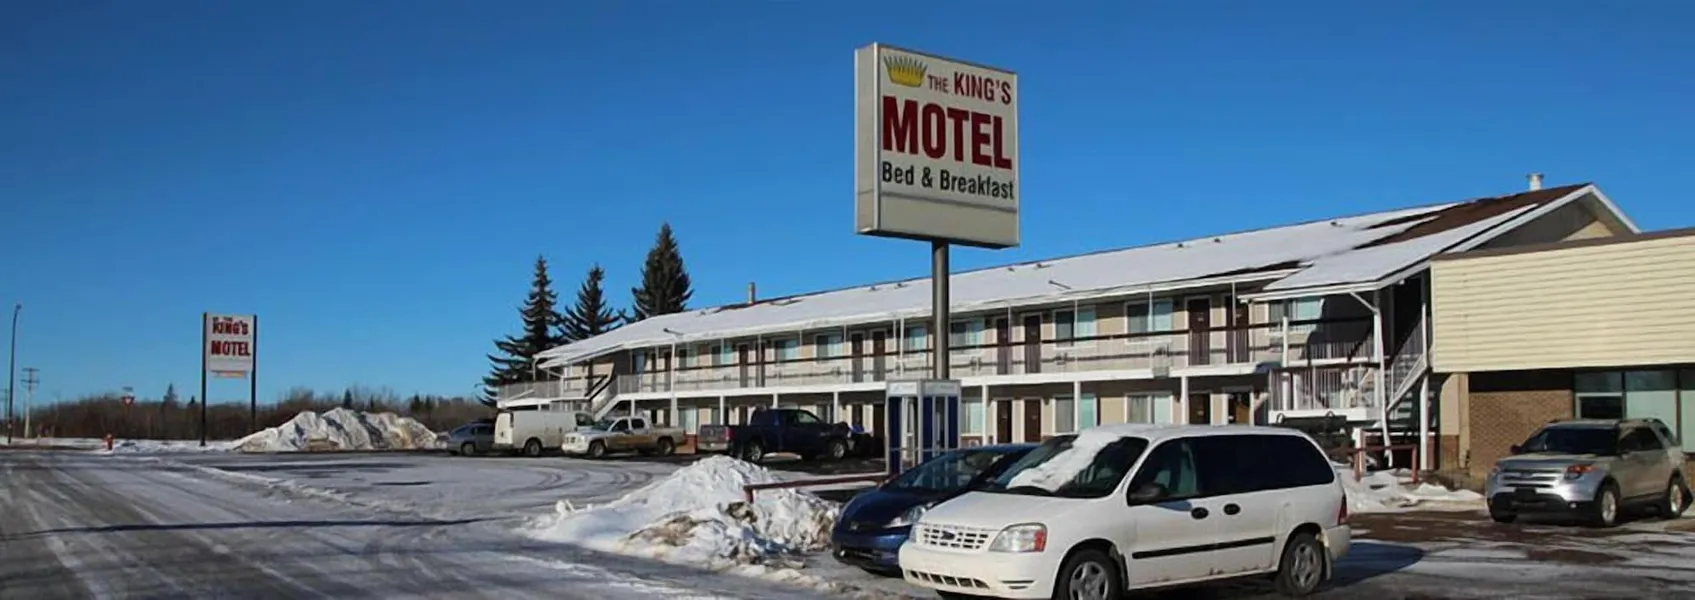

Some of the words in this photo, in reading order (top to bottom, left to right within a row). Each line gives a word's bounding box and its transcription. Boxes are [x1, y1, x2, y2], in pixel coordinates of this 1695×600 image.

[928, 75, 949, 93] THE
[954, 71, 1012, 105] KING'S
[882, 95, 1013, 170] MOTEL
[882, 161, 914, 185] Bed
[921, 167, 933, 188] &
[940, 169, 1014, 200] Breakfast
[211, 340, 251, 356] MOTEL
